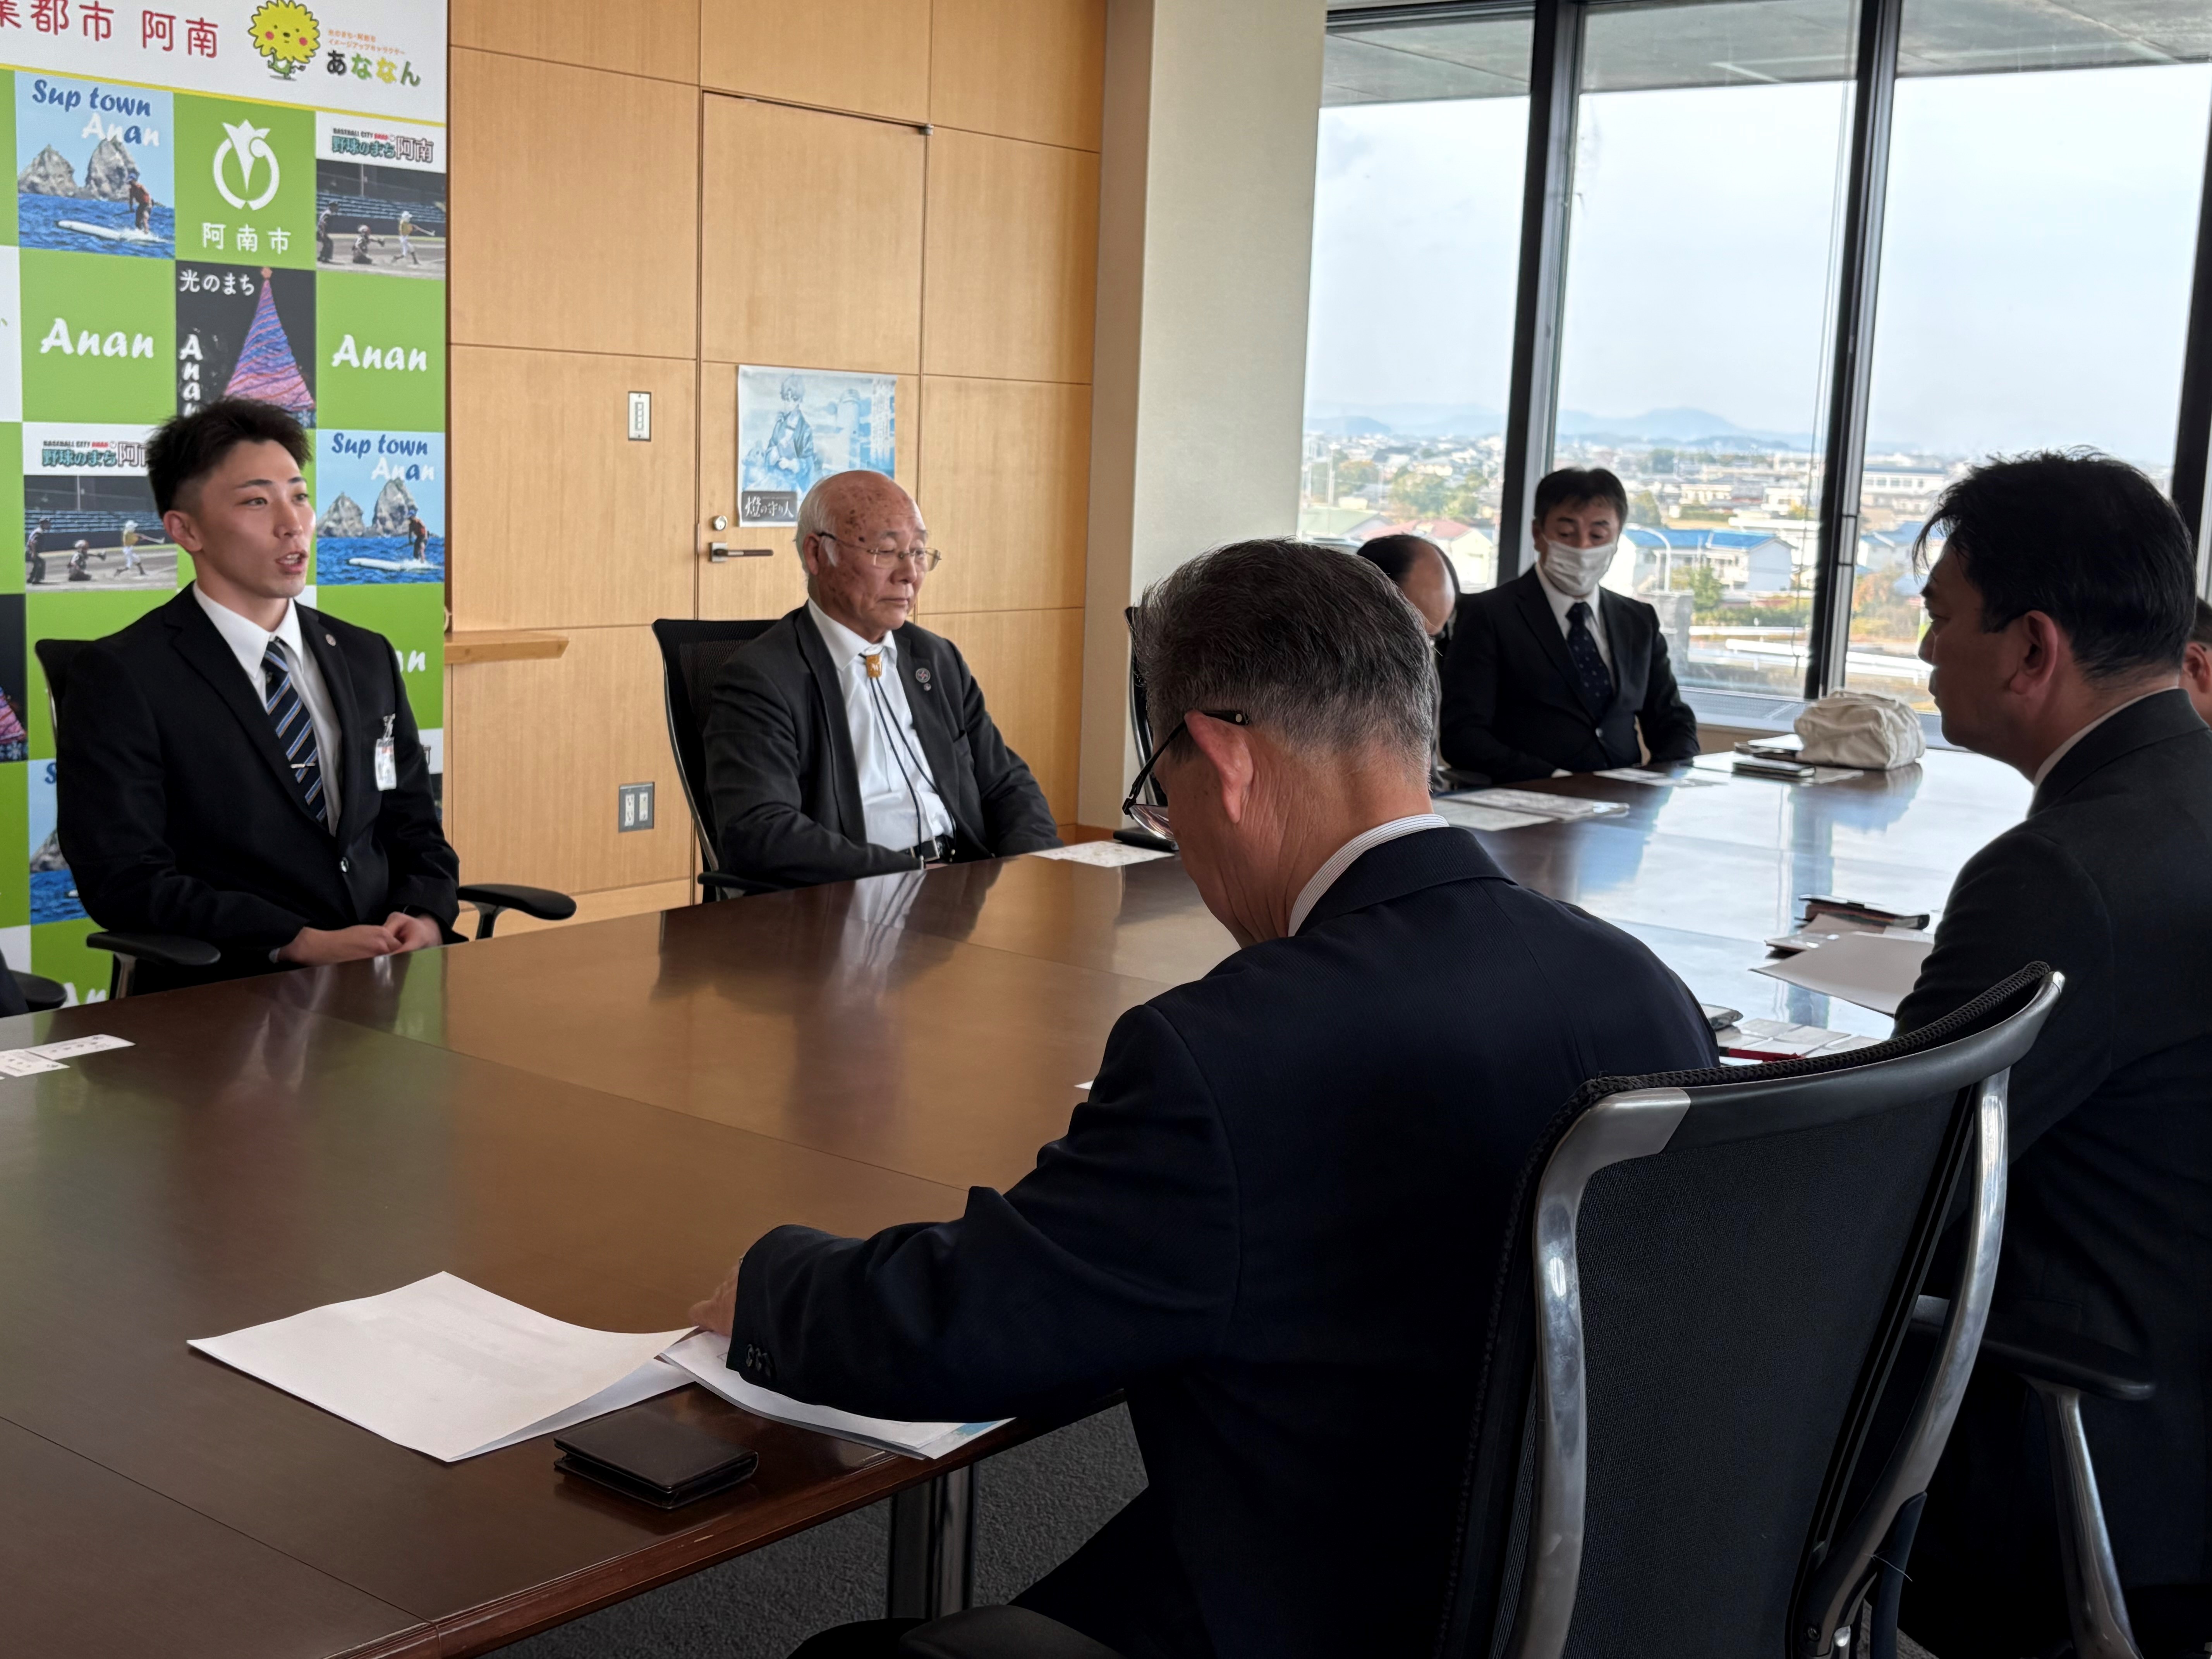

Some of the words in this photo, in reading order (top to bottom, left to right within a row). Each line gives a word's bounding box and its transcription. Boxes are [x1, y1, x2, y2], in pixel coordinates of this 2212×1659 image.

[141, 10, 219, 58] 阿南
[327, 50, 421, 87] あななん
[32, 79, 81, 112] Sup
[90, 87, 150, 116] town
[81, 112, 159, 146] Anan
[202, 222, 291, 254] 阿南市
[180, 269, 254, 295] 光のまち
[40, 318, 154, 358] Anan
[331, 334, 427, 372] Anan
[331, 432, 371, 459] Sup
[378, 434, 428, 456] town
[371, 457, 434, 481] Anan
